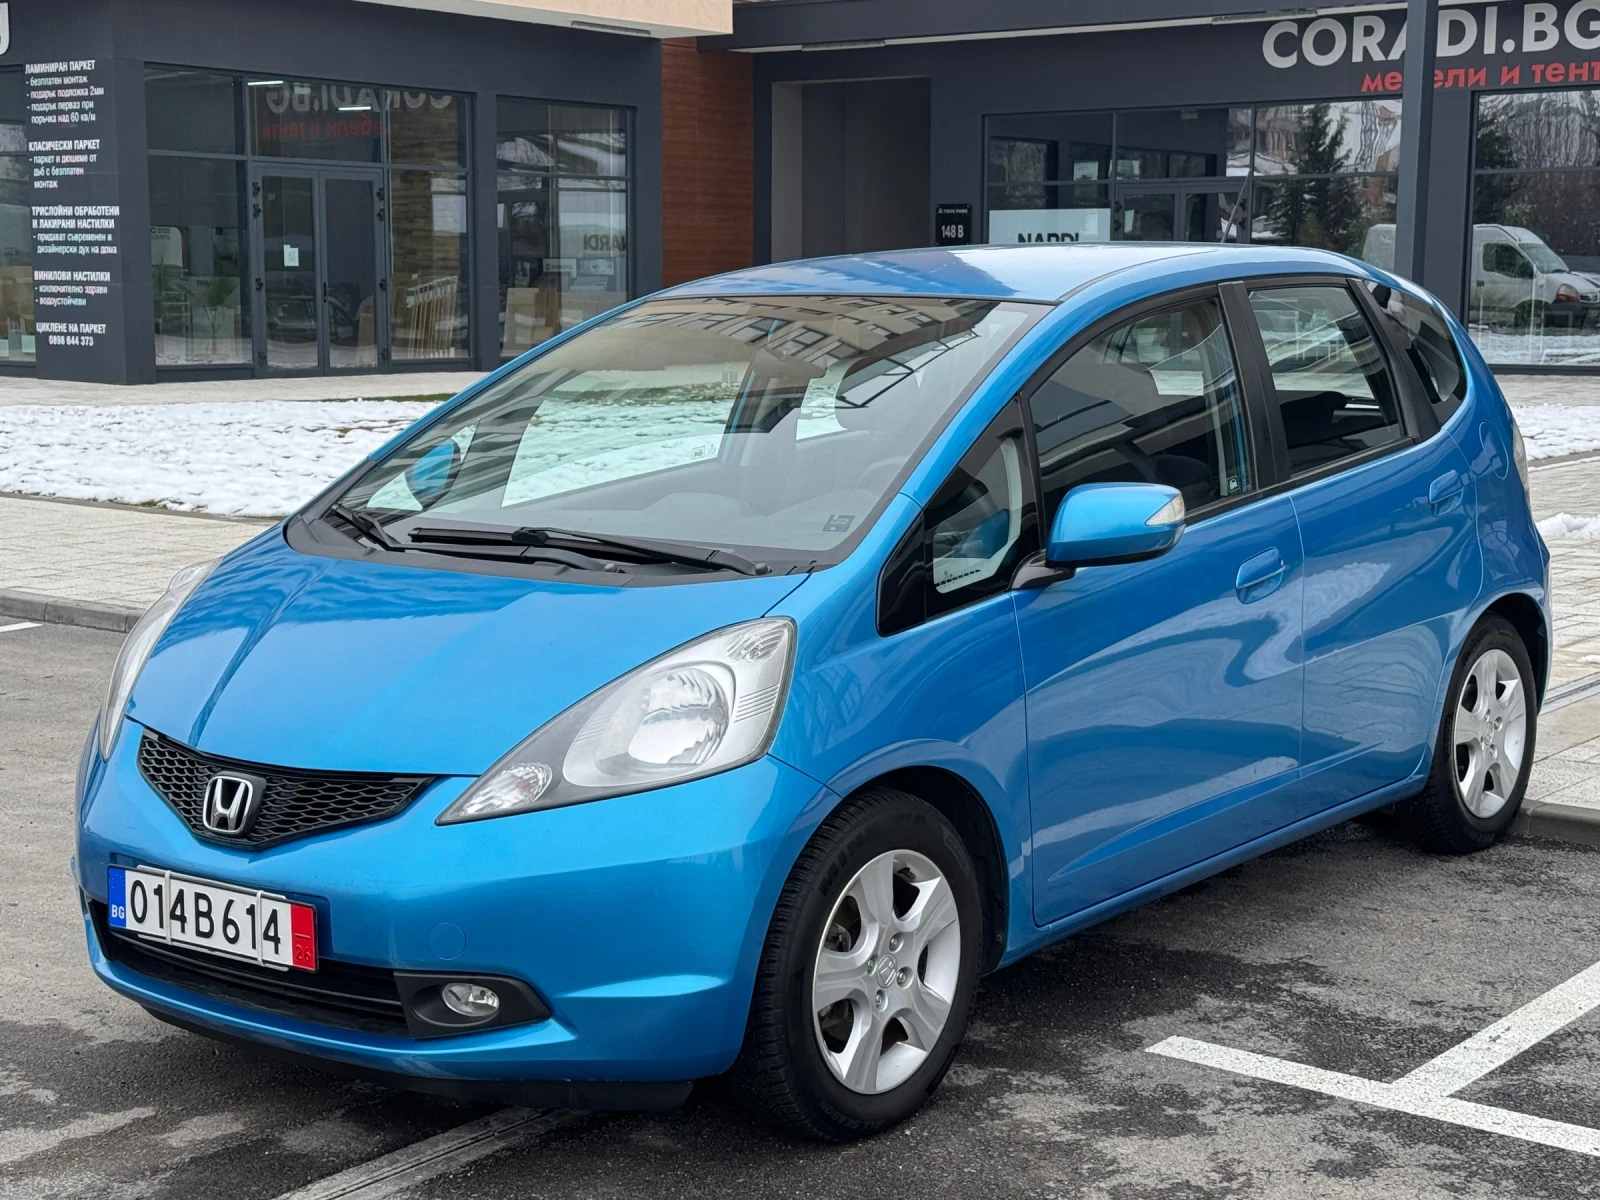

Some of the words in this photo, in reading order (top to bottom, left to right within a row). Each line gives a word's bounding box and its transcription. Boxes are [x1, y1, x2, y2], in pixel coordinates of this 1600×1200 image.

[1262, 0, 1600, 69] CORDI.BG
[25, 62, 68, 74] ЛАМИНИРАН
[69, 60, 95, 71] ПАРКЕТ
[30, 76, 62, 86] безплатен
[63, 75, 88, 85] монтаж
[1361, 66, 1487, 92] меели
[1501, 64, 1520, 86] и
[30, 89, 57, 100] подарък
[57, 88, 89, 98] подложка
[90, 86, 104, 96] 2мм
[31, 102, 57, 112] подарък
[58, 101, 80, 111] перваз
[81, 100, 94, 111] при
[31, 114, 57, 125] поръчка
[58, 114, 70, 123] над
[70, 112, 80, 122] 60
[28, 140, 73, 151] КЛАСИЧЕСКИ
[74, 139, 100, 150] ПАРКЕТ
[33, 155, 55, 165] паркет
[56, 155, 61, 163] и
[61, 154, 88, 164] дюшеме
[89, 154, 97, 163] от
[33, 166, 45, 177] дъб
[45, 168, 50, 176] с
[51, 166, 84, 176] безплатен
[34, 180, 58, 188] монтаж
[31, 204, 73, 216] ТРИСЛОЙНИ
[74, 205, 120, 216] ОБРАБОТЕНИ
[32, 219, 38, 229] И
[39, 219, 76, 229] ЛАКИРАНИ
[77, 219, 115, 229] НАСТИЛКИ
[941, 224, 956, 238] 148
[67, 233, 106, 243] съвременен
[107, 233, 112, 241] и
[78, 245, 90, 256] дух
[91, 246, 99, 254] на
[100, 246, 117, 254] дома
[34, 270, 72, 281] ВИНИЛОВИ
[73, 271, 111, 282] НАСТИЛКИ
[84, 285, 108, 296] здрави
[39, 296, 86, 307] водоустойчеви
[36, 322, 67, 333] ЦИКЛЕНЕ
[68, 323, 79, 333] НА
[80, 323, 106, 334] ПАРКЕТ
[48, 335, 65, 345] 0898
[66, 335, 79, 346] 644
[80, 336, 94, 347] 373
[111, 904, 125, 919] BG
[130, 879, 281, 955] 014B614
